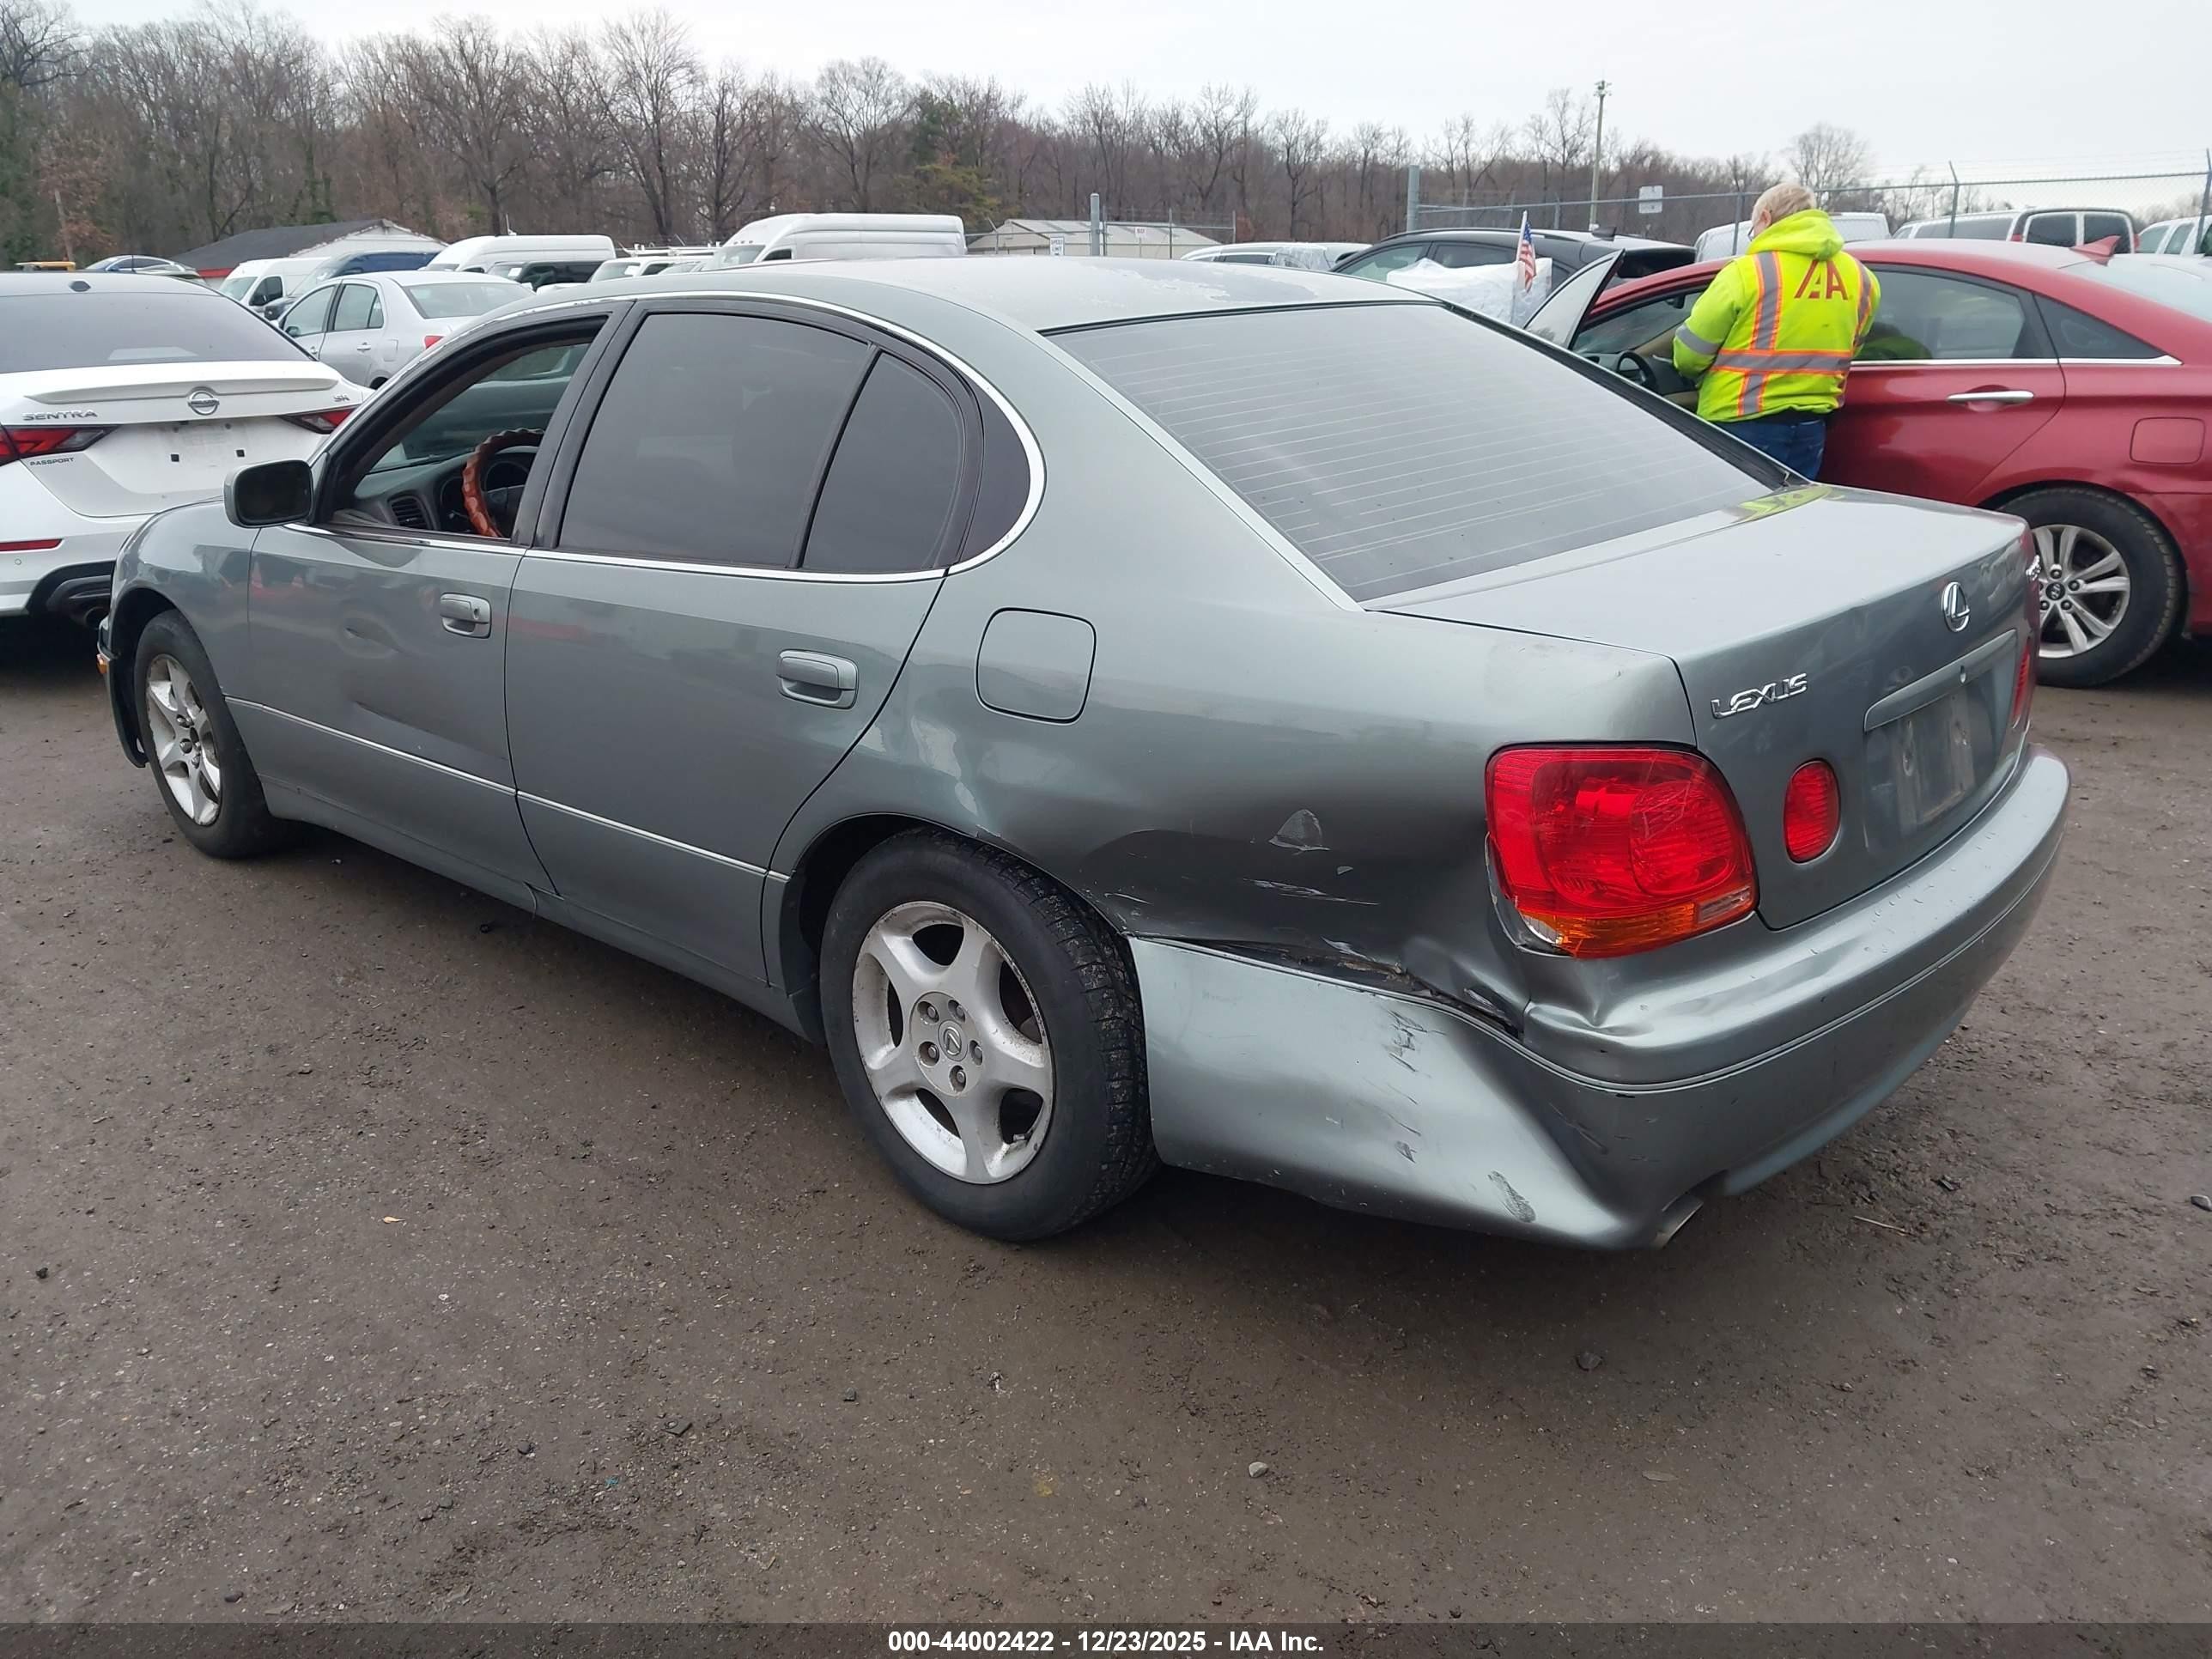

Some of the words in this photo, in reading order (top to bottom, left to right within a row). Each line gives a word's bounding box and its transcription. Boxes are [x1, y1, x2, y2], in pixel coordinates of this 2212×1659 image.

[22, 411, 98, 421] SENTRA
[30, 457, 75, 465] PASSPORT
[1711, 672, 1807, 719] LEXUS
